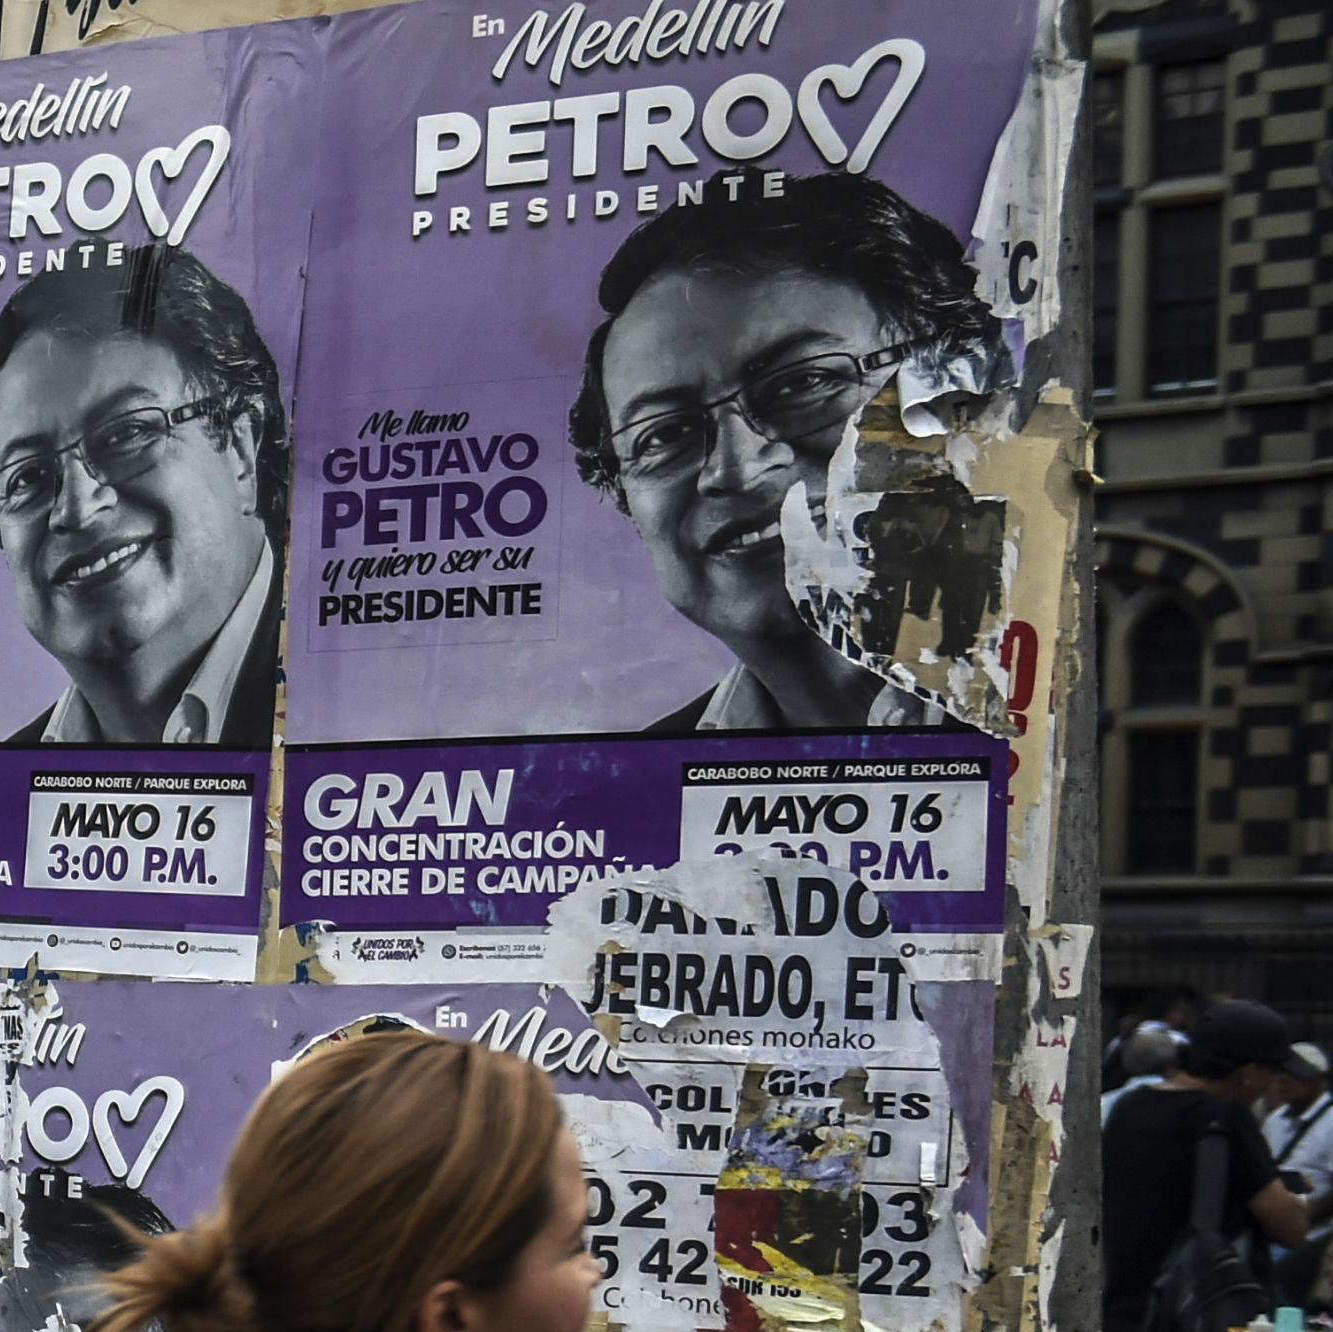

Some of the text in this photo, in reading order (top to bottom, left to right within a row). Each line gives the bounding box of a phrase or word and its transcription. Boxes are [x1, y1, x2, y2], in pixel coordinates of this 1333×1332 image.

[472, 14, 505, 39] En
[414, 74, 793, 197] PETRO
[412, 170, 786, 237] PRESIDENTE
[358, 409, 470, 443] Me llamo
[322, 433, 539, 485] GUSTAVO
[321, 476, 548, 549] PETRO
[321, 546, 535, 593] y quiero ser su
[319, 583, 542, 627] PRESIDENTE
[33, 775, 93, 789] CARABOBO
[95, 776, 132, 789] NORTE
[144, 777, 191, 791] PARQUE
[193, 779, 247, 792] EXPLORA
[687, 765, 772, 781] CARABOBO
[777, 765, 828, 780] NORTE
[844, 764, 907, 780] PARQUE
[910, 763, 981, 778] EXPLORA
[303, 769, 515, 831] GRAN
[714, 793, 943, 836] MAYO 16
[50, 803, 217, 842] MAYO 16
[302, 822, 605, 863] CONCENTRACIÓN
[47, 845, 218, 886] 3:00 P.M.
[849, 840, 949, 882] P.M.
[301, 869, 409, 898] CIERRE
[422, 867, 465, 896] DE
[435, 1006, 468, 1029] En
[762, 1027, 875, 1050] monako
